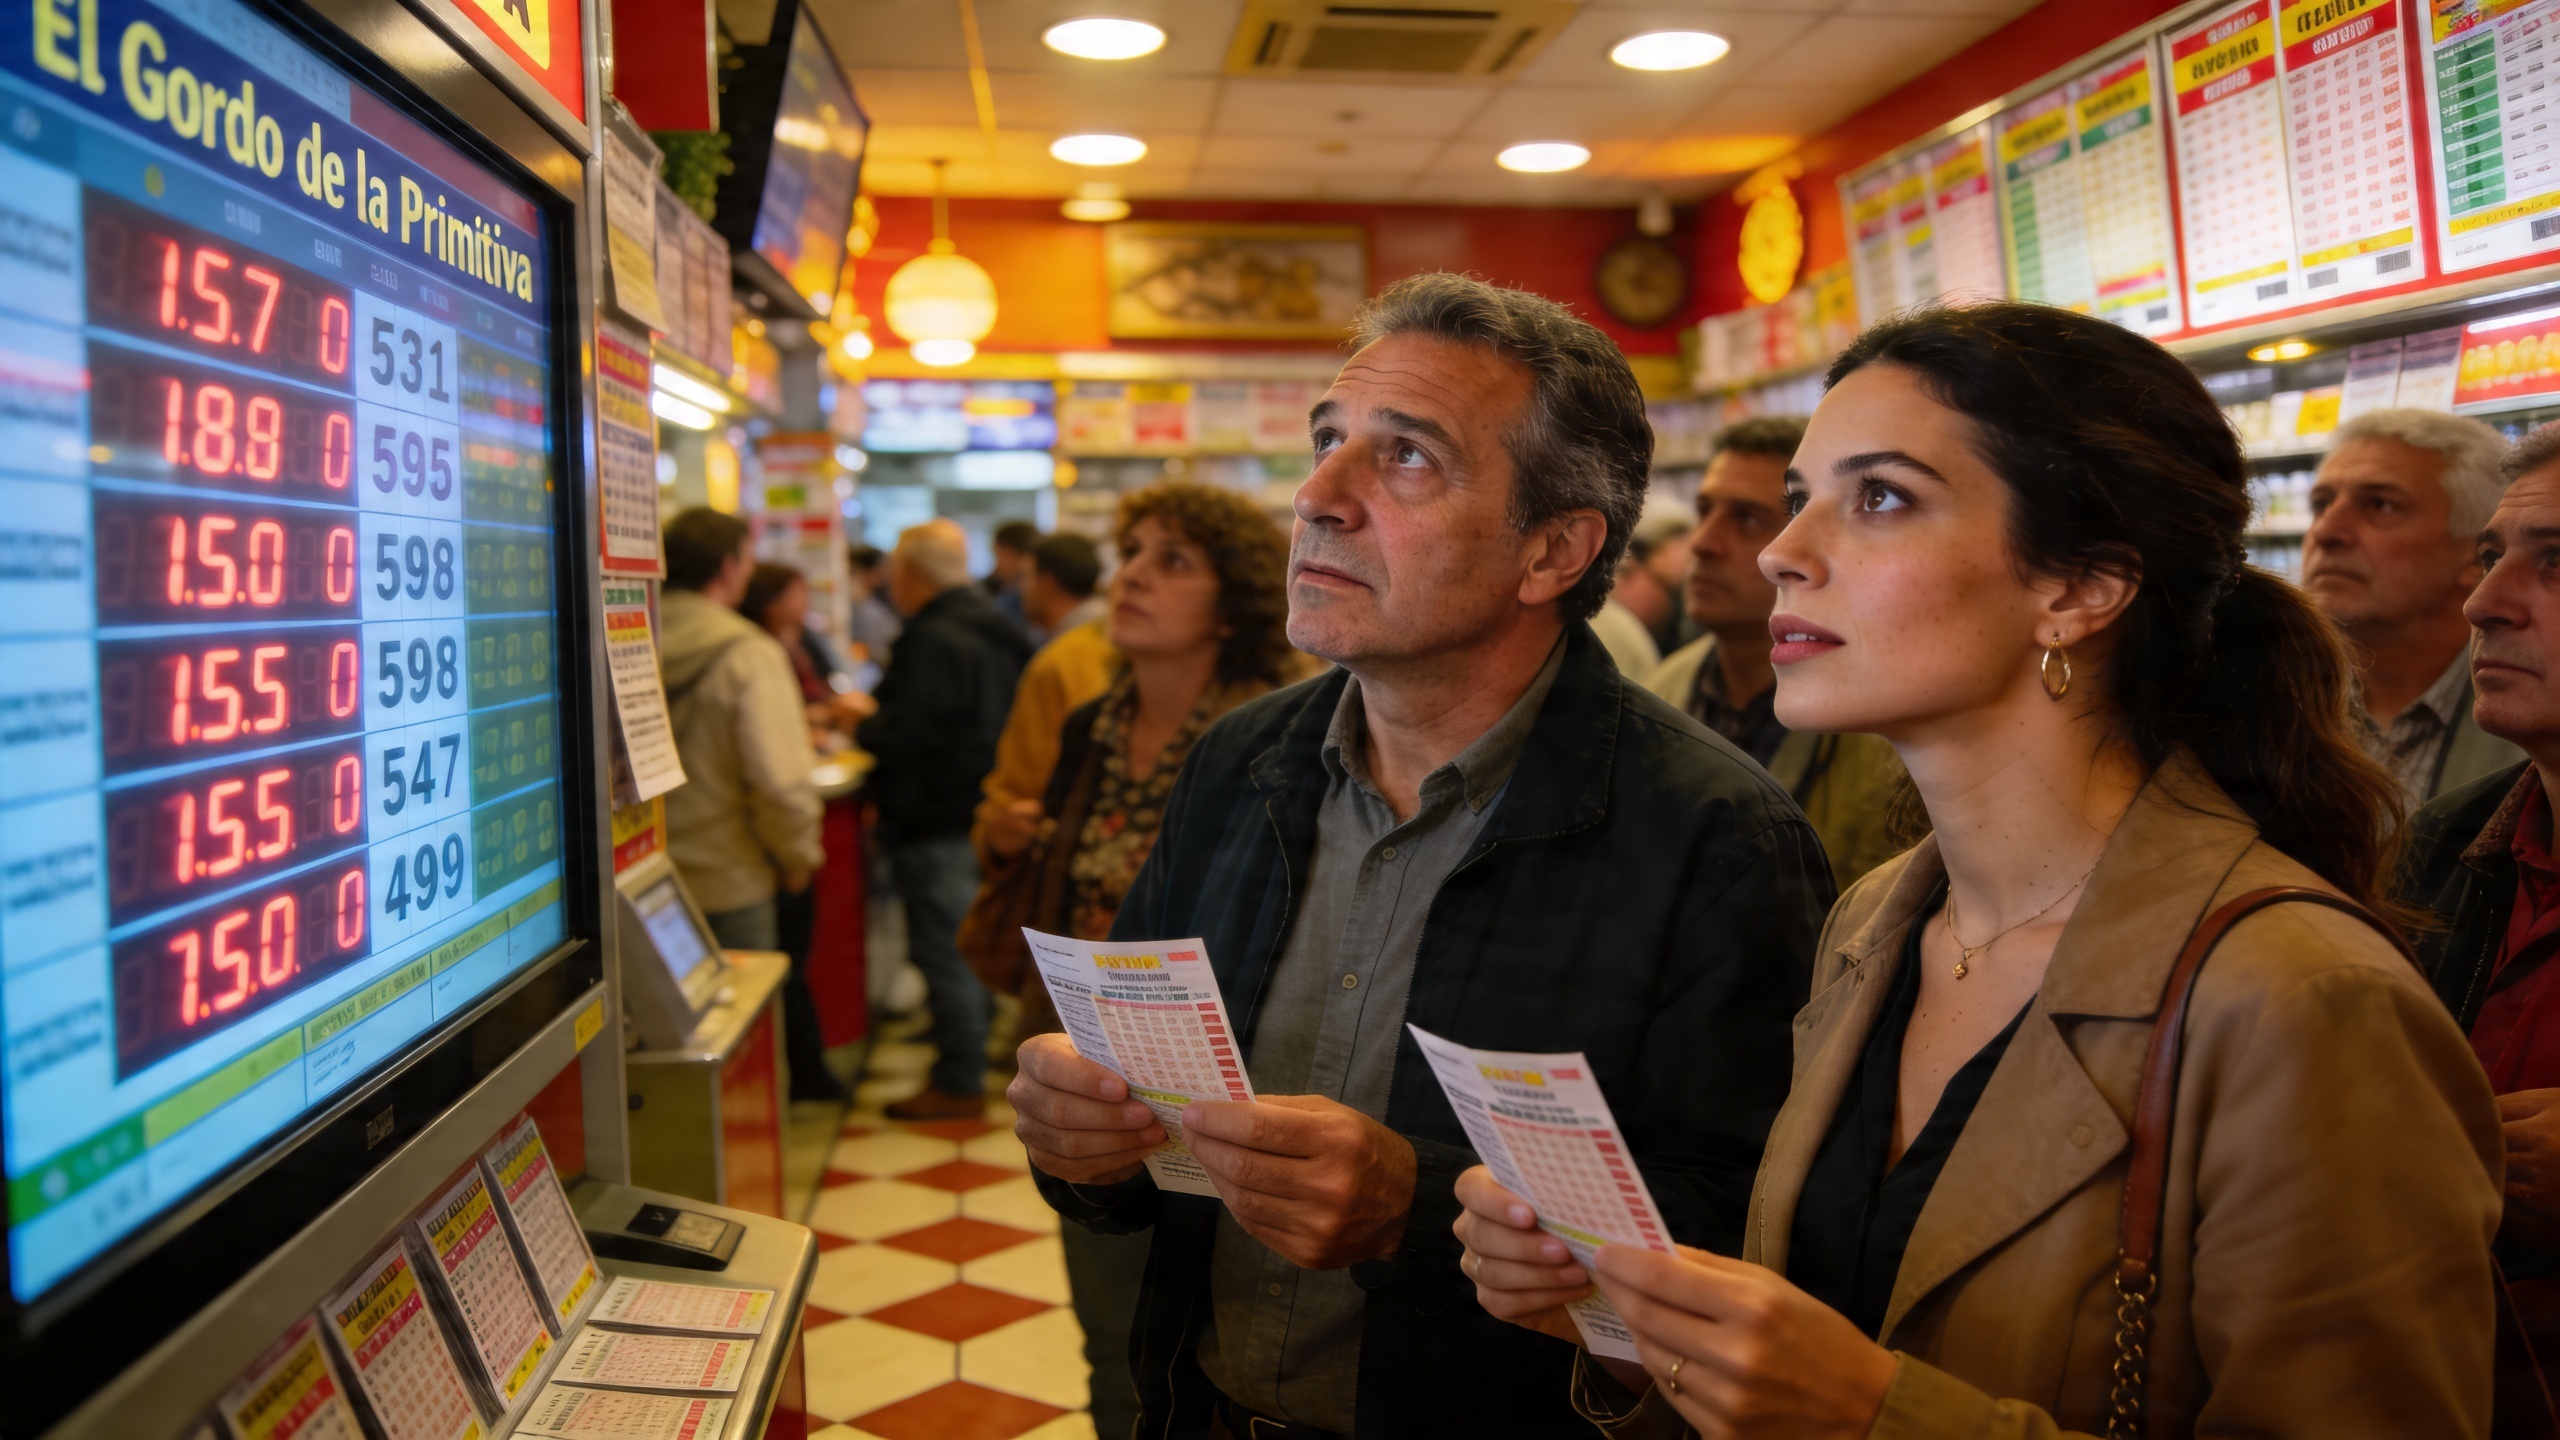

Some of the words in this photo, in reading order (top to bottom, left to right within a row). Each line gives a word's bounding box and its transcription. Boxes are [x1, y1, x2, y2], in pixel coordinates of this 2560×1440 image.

[33, 0, 106, 95] El
[119, 20, 284, 178] Gordo
[296, 122, 345, 209] de
[357, 148, 388, 233] la
[401, 175, 533, 303] Primitiva
[320, 297, 349, 374] 0
[370, 316, 449, 404] 531
[324, 413, 350, 488] 0
[372, 424, 452, 501] 595
[326, 528, 354, 603] 0
[376, 533, 454, 601] 598
[330, 642, 357, 717] 0
[379, 635, 458, 709] 598
[334, 756, 361, 833] 0
[383, 733, 460, 816] 547
[337, 870, 364, 948] 0
[385, 831, 464, 922] 499
